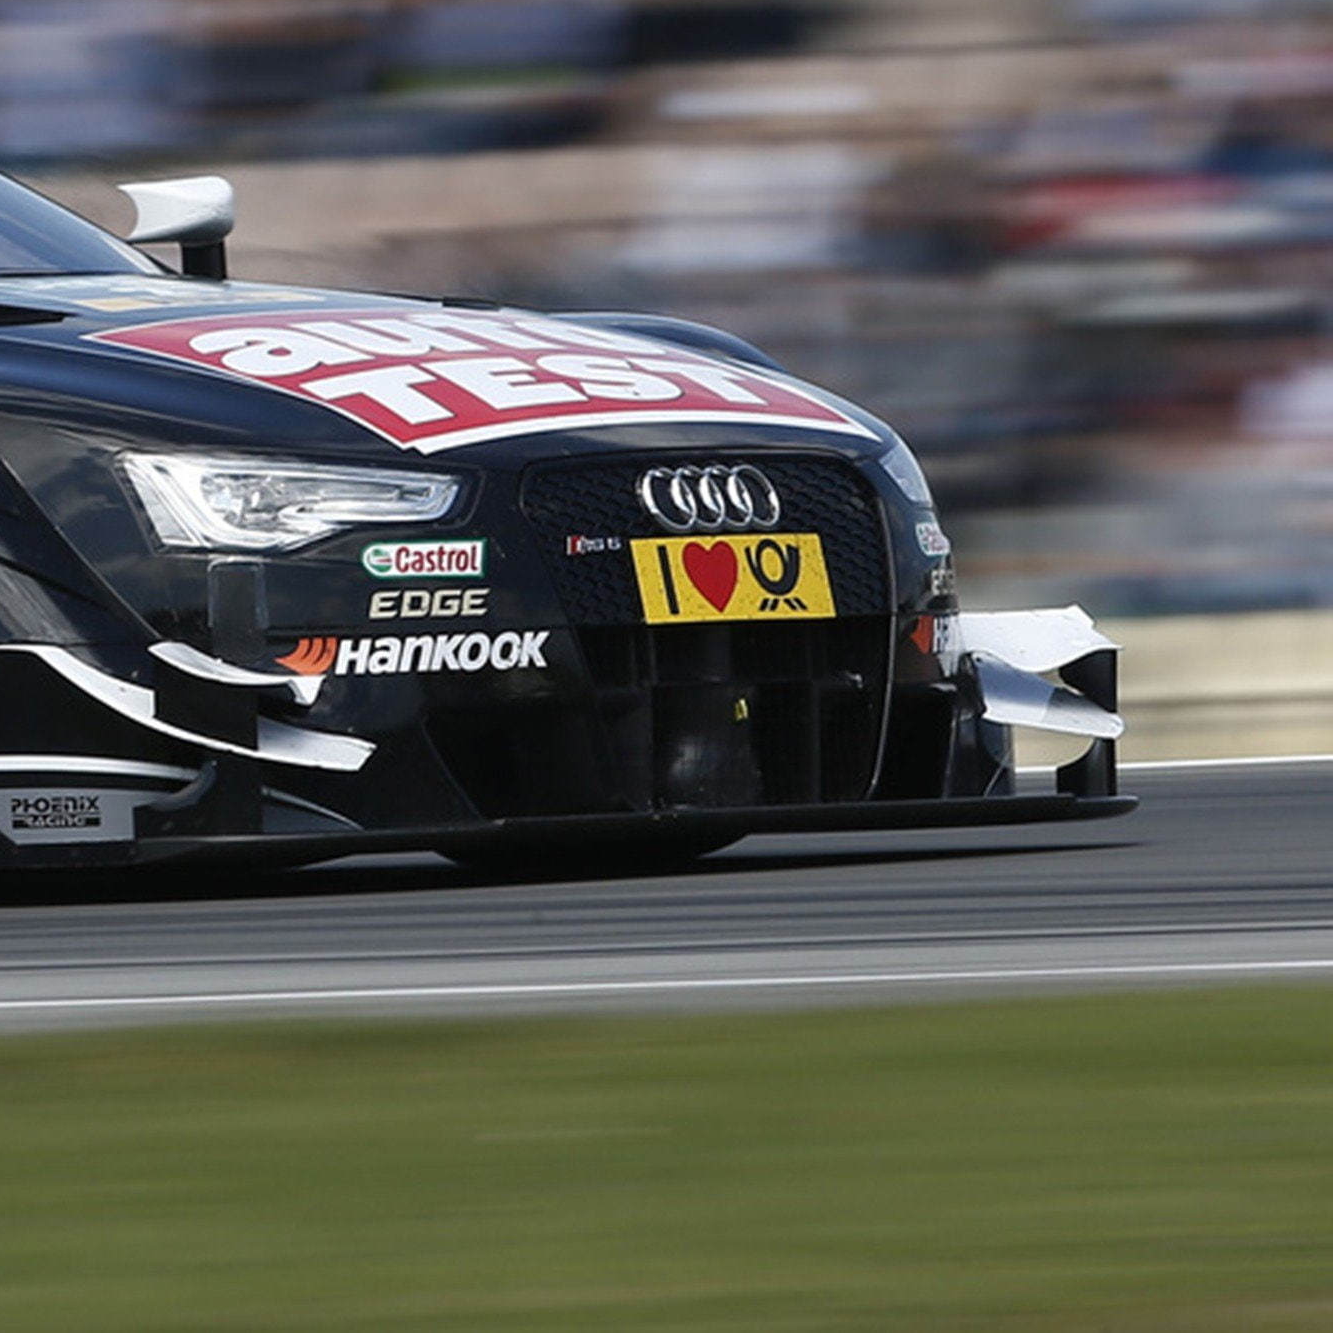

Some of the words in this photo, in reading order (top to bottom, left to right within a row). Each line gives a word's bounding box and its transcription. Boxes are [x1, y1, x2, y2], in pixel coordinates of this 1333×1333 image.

[188, 314, 668, 377] auto
[300, 354, 769, 425] TEST
[395, 545, 480, 574] Castrol
[368, 587, 491, 620] EDGE
